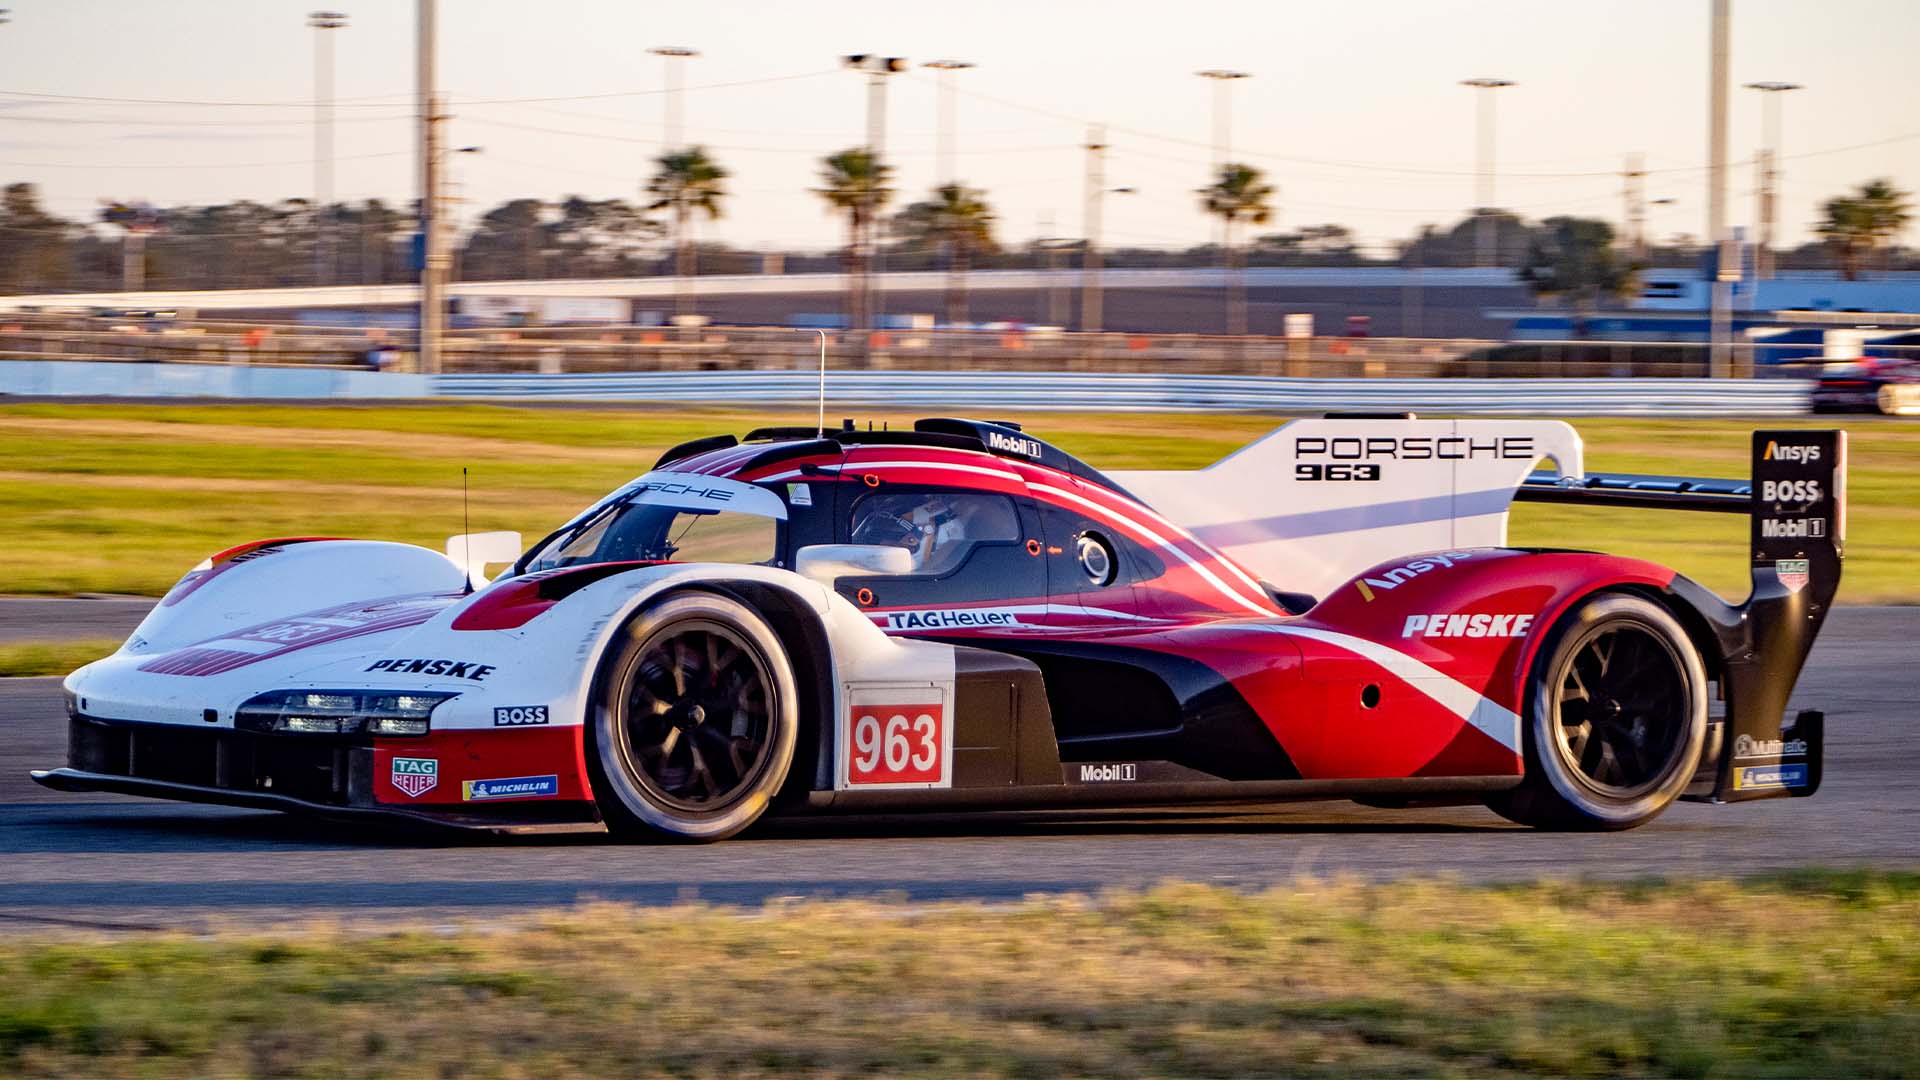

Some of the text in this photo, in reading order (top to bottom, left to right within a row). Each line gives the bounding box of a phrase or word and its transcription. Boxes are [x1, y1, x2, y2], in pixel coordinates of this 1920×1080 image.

[989, 432, 1027, 454] Mobil
[1296, 437, 1534, 460] PORSCHE
[1763, 441, 1821, 464] Ansys
[1296, 464, 1380, 481] 963
[1762, 480, 1819, 502] BOSS
[1762, 519, 1808, 537] Mobil
[1355, 552, 1472, 602] Ansys
[1402, 614, 1535, 638] PENSKE
[363, 659, 497, 681] PENSKE
[497, 707, 545, 724] BOSS
[855, 714, 937, 773] 963
[396, 760, 433, 773] TAG
[1081, 764, 1120, 781] Mobil
[394, 775, 434, 793] HEUER
[490, 781, 550, 793] MICHELIN
